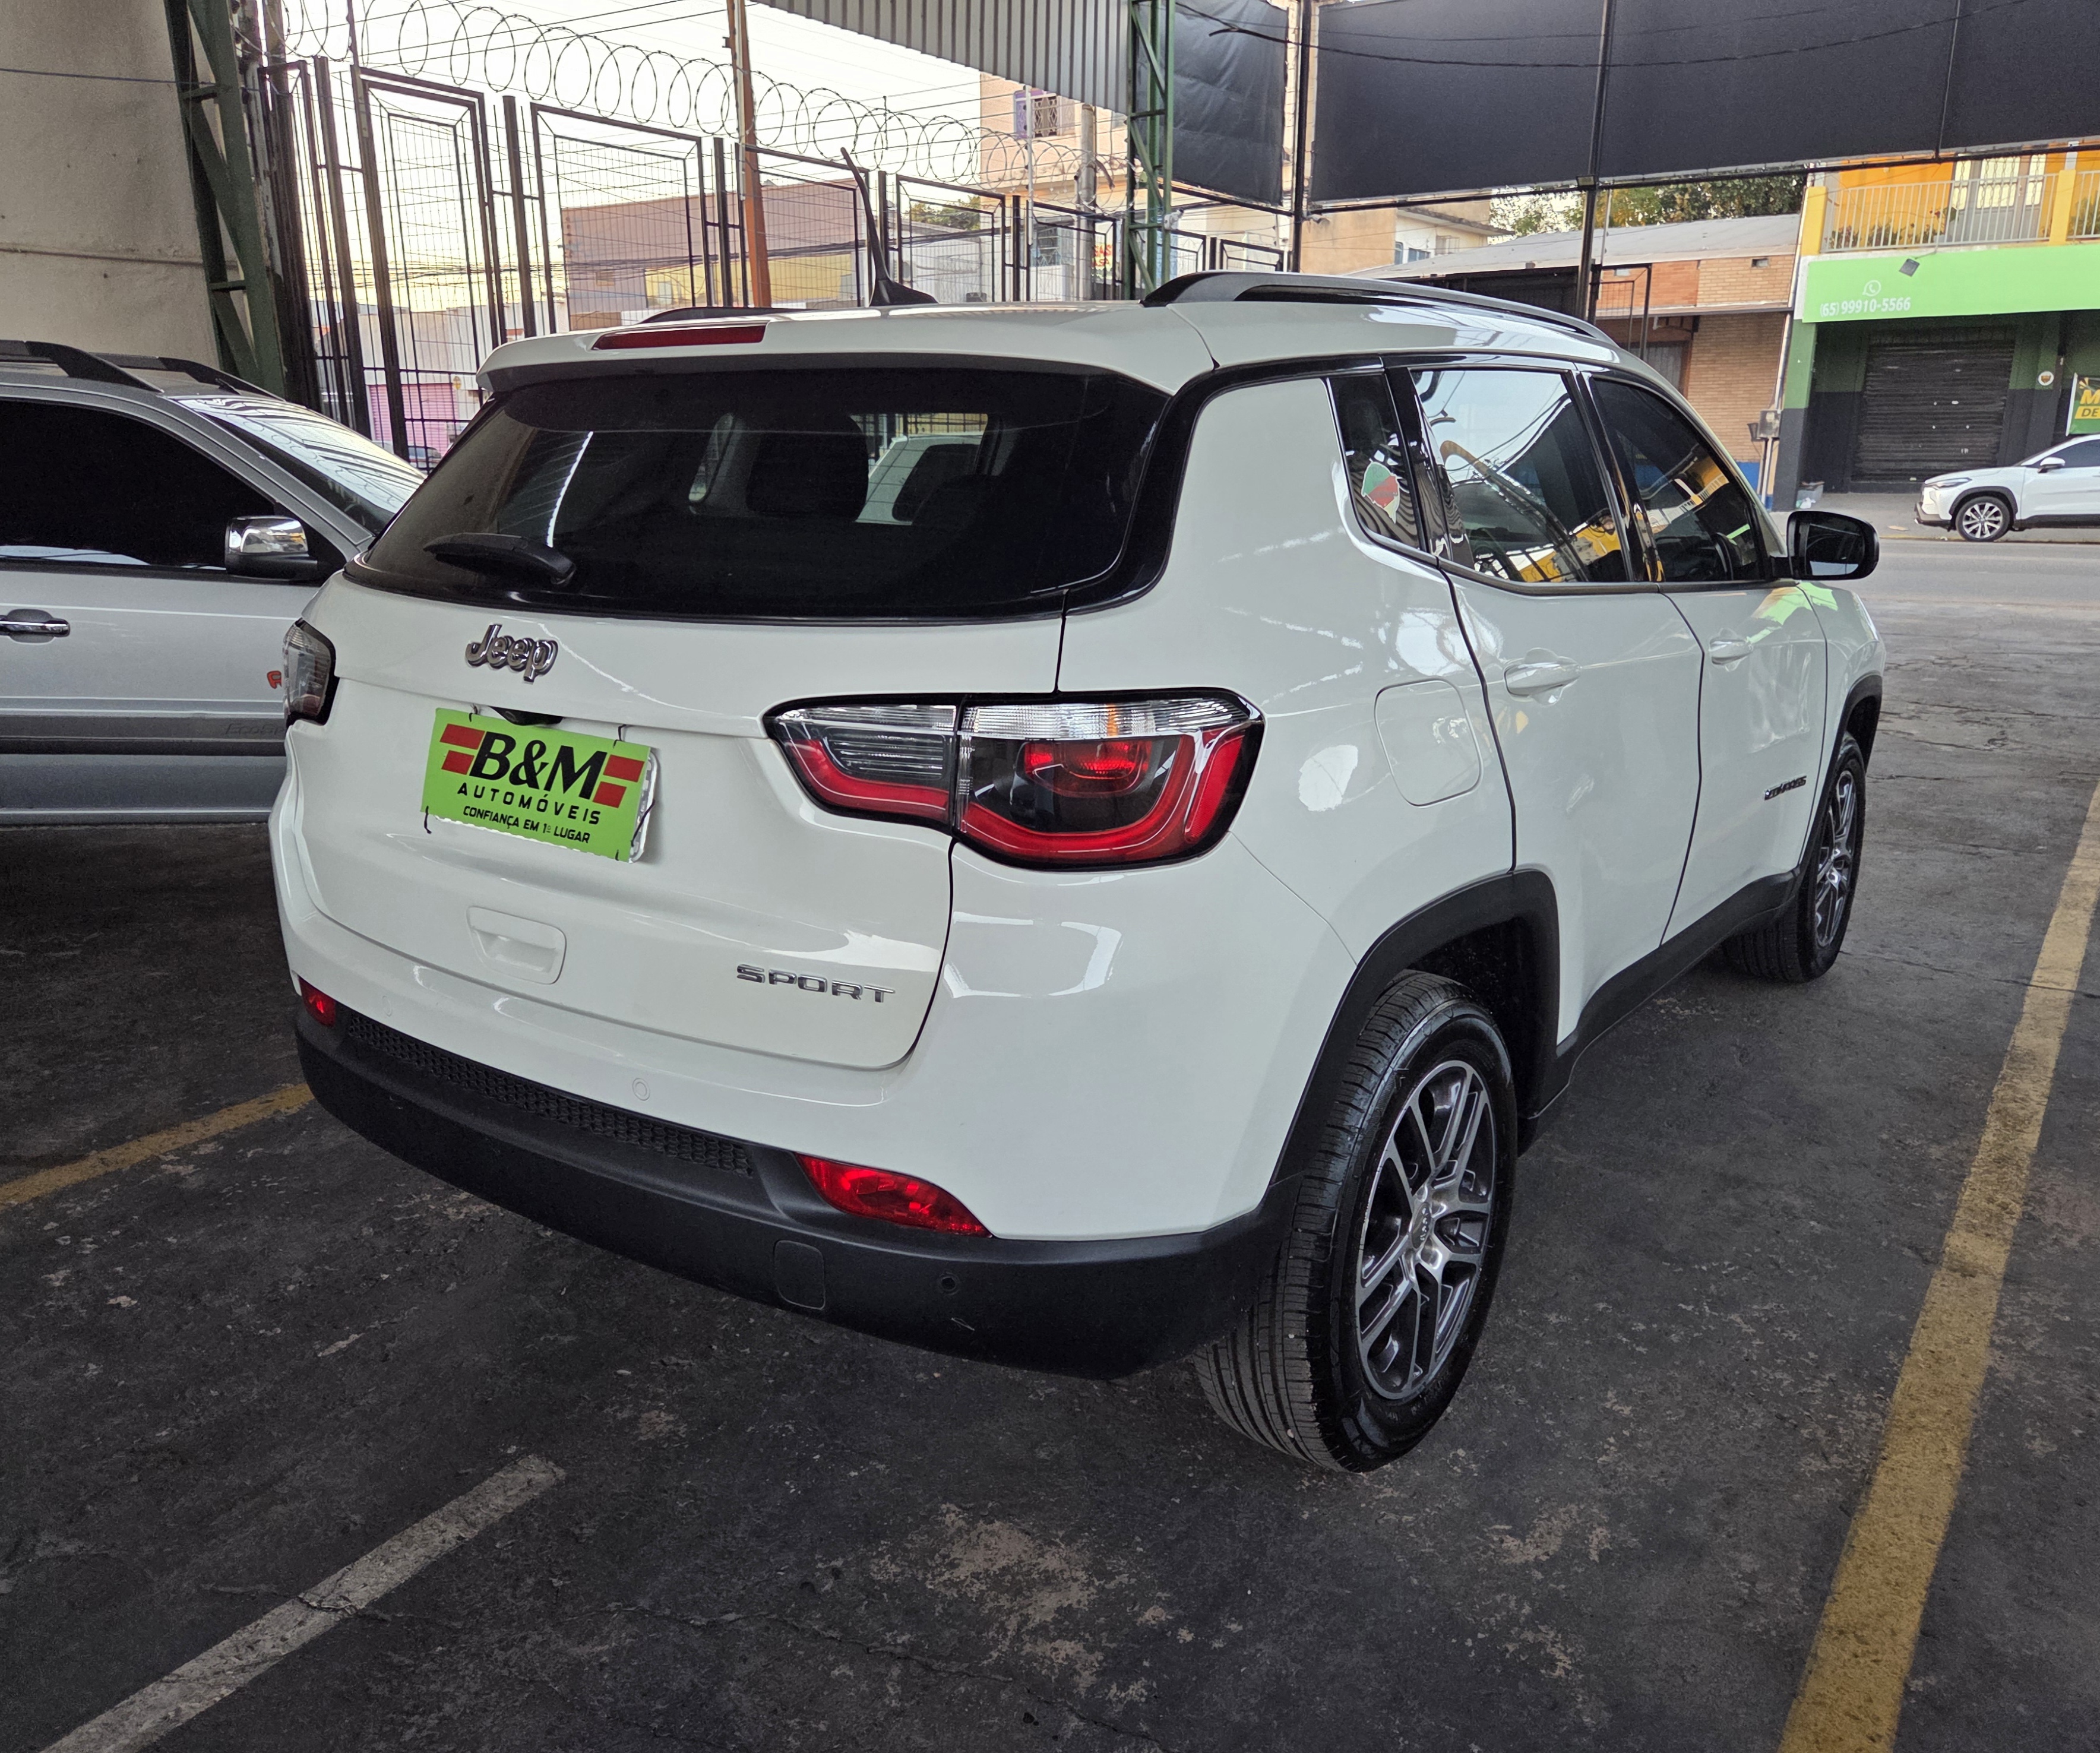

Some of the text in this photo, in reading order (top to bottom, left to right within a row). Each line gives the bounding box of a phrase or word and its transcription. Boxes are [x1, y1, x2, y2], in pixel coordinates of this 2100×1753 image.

[1820, 297, 1911, 317] (65) 99910-5566
[465, 624, 558, 684] Jeep
[469, 730, 608, 800] B&M
[457, 782, 601, 825] AUTOMÓVEIS
[463, 805, 520, 829] CONFIANÇA
[523, 819, 540, 832] EM
[554, 825, 591, 844] LUGAR
[736, 964, 896, 1004] SPORT
